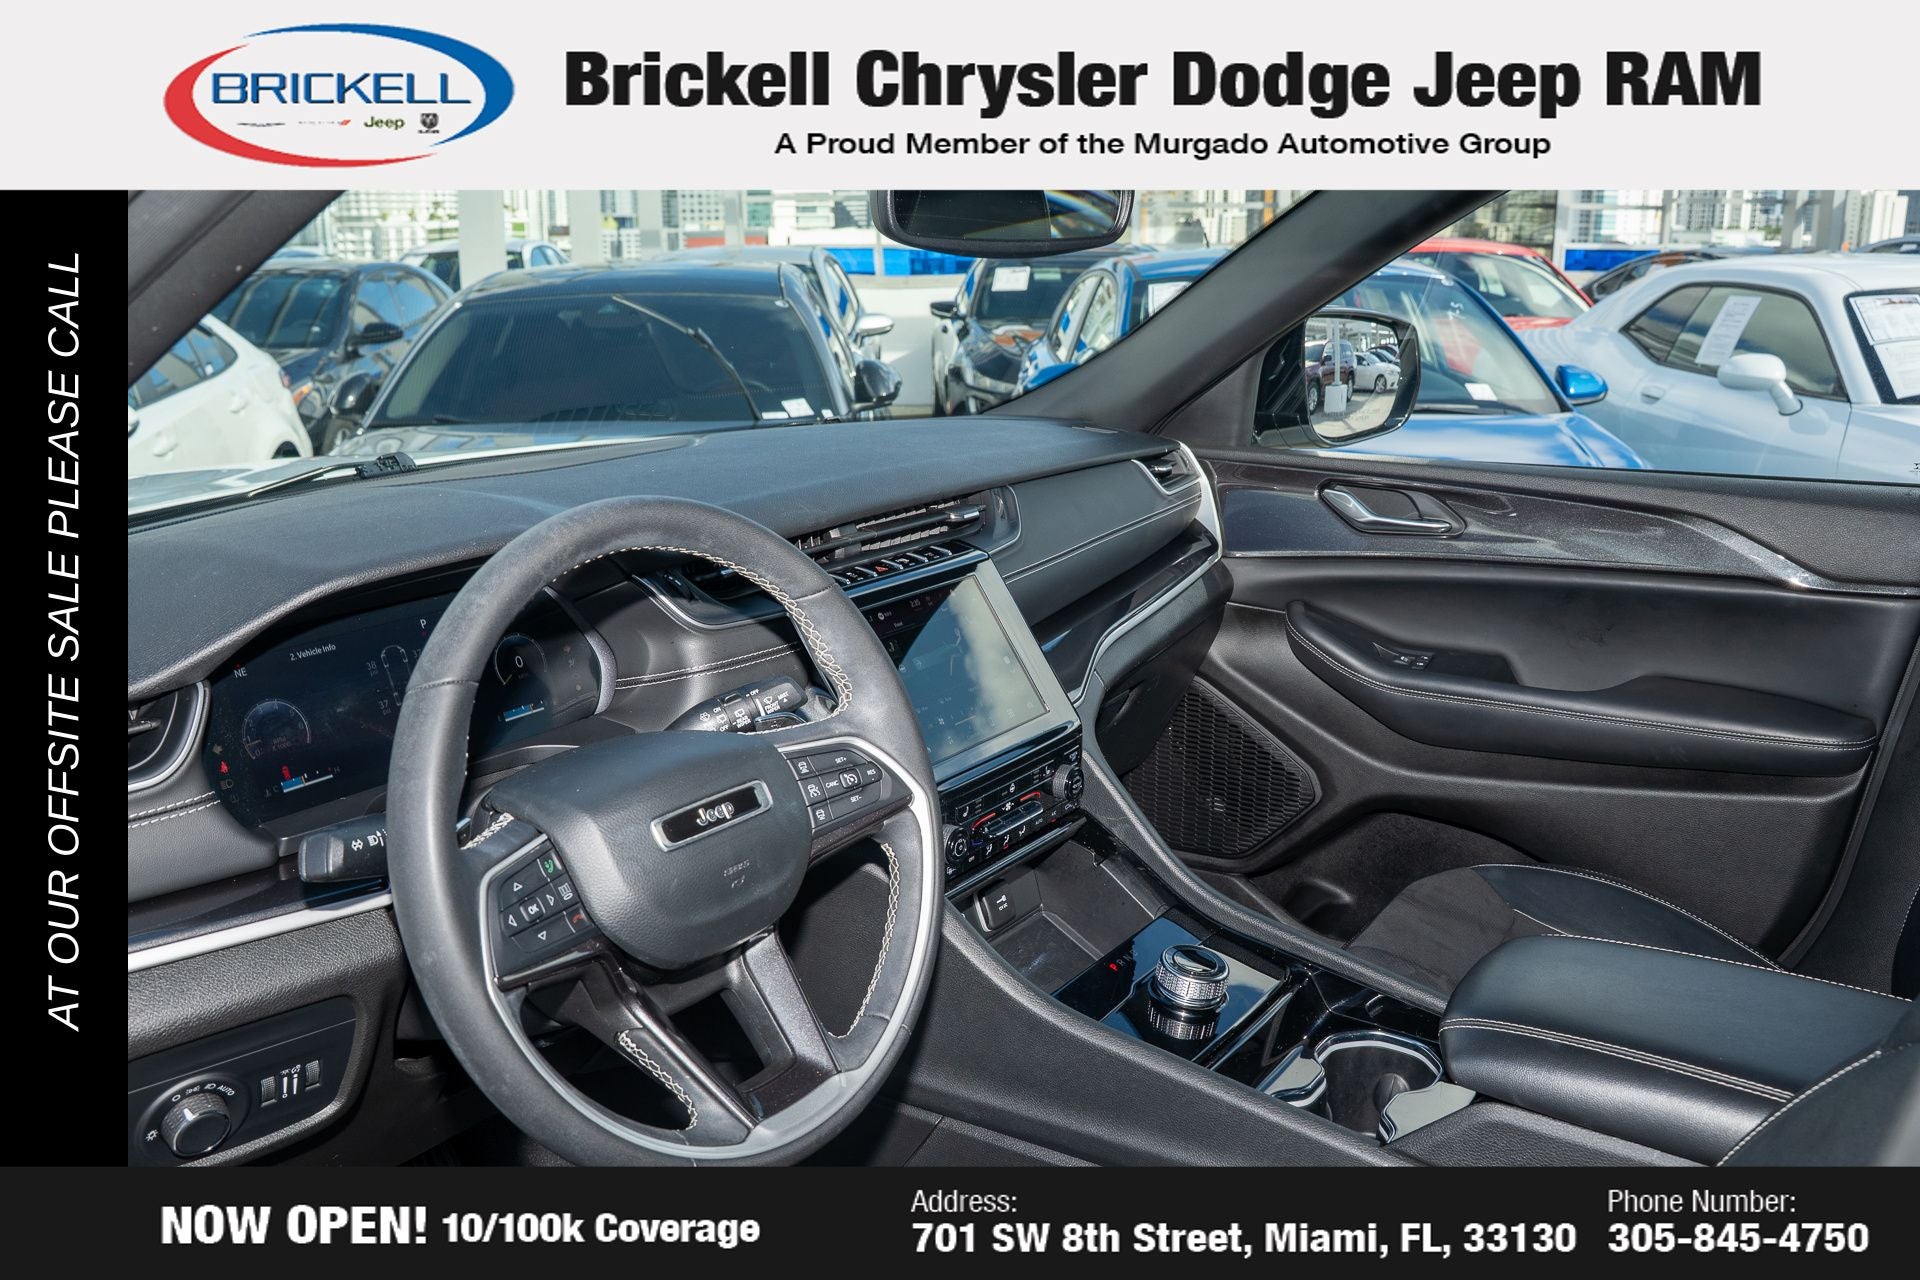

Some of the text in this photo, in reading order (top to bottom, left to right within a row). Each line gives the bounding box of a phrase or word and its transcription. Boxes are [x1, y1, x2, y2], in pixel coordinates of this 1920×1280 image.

[297, 647, 322, 659] Vehicle
[322, 643, 336, 653] Info
[234, 667, 247, 678] NE
[696, 802, 735, 826] Jeep
[528, 904, 539, 914] OK
[217, 1084, 235, 1096] AUTO
